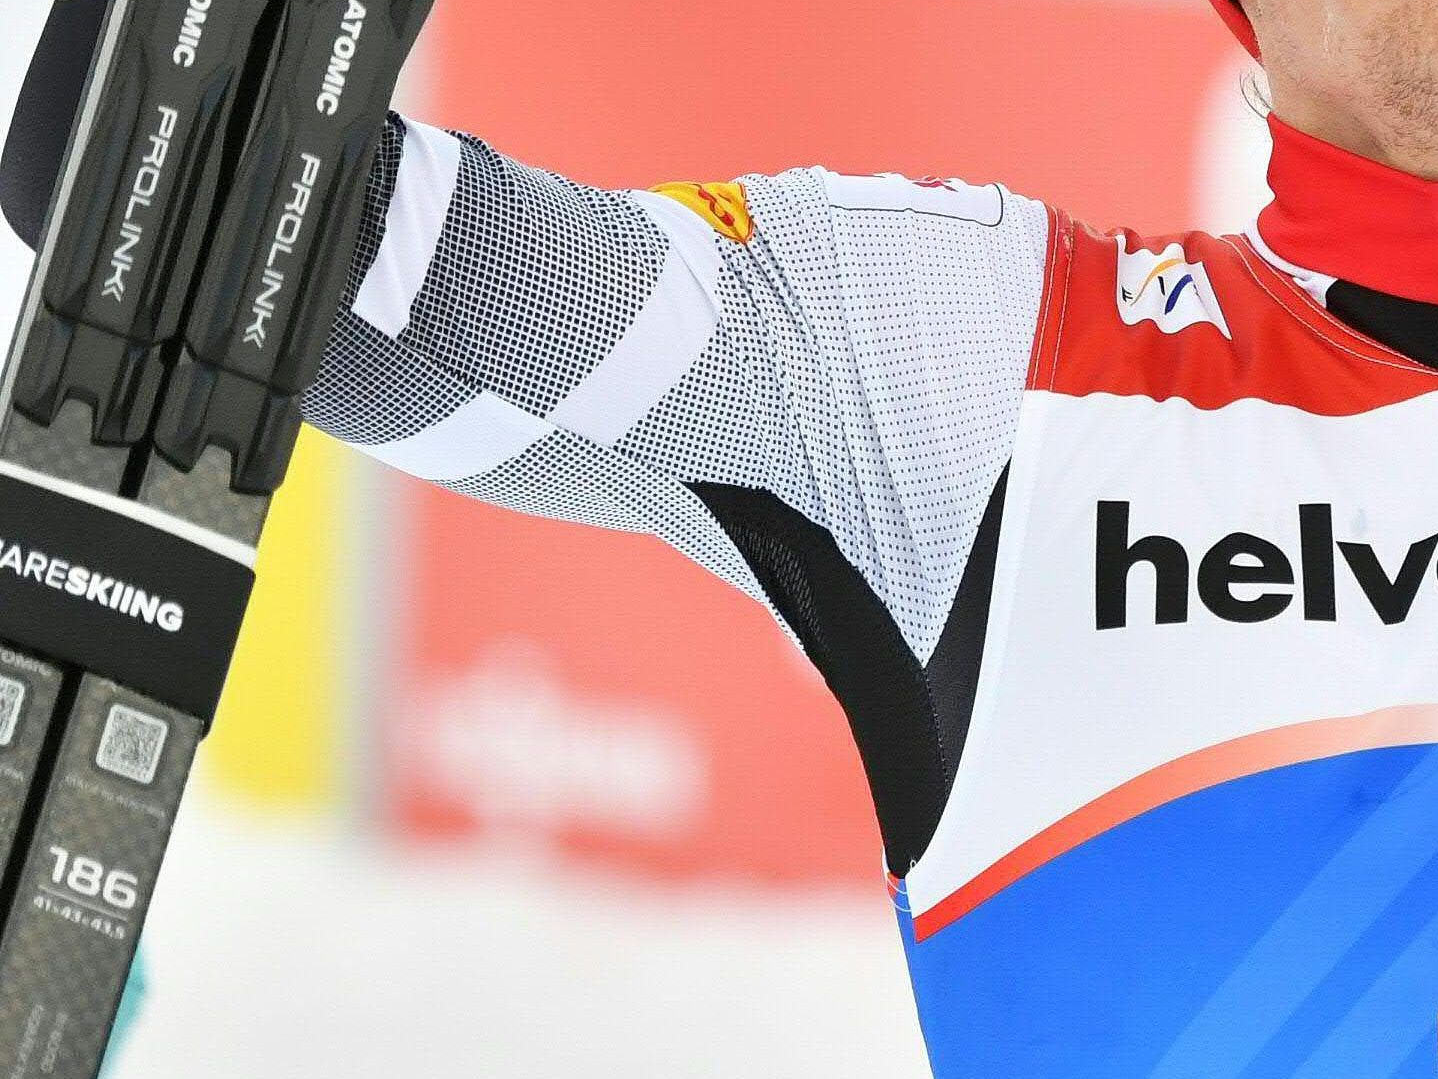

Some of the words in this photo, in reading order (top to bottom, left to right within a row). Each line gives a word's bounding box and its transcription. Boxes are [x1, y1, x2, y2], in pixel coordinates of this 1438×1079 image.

[101, 105, 178, 303] PROLINK
[242, 152, 321, 349] PROLINK
[0, 538, 185, 633] ARESKIING
[49, 845, 139, 910] 186
